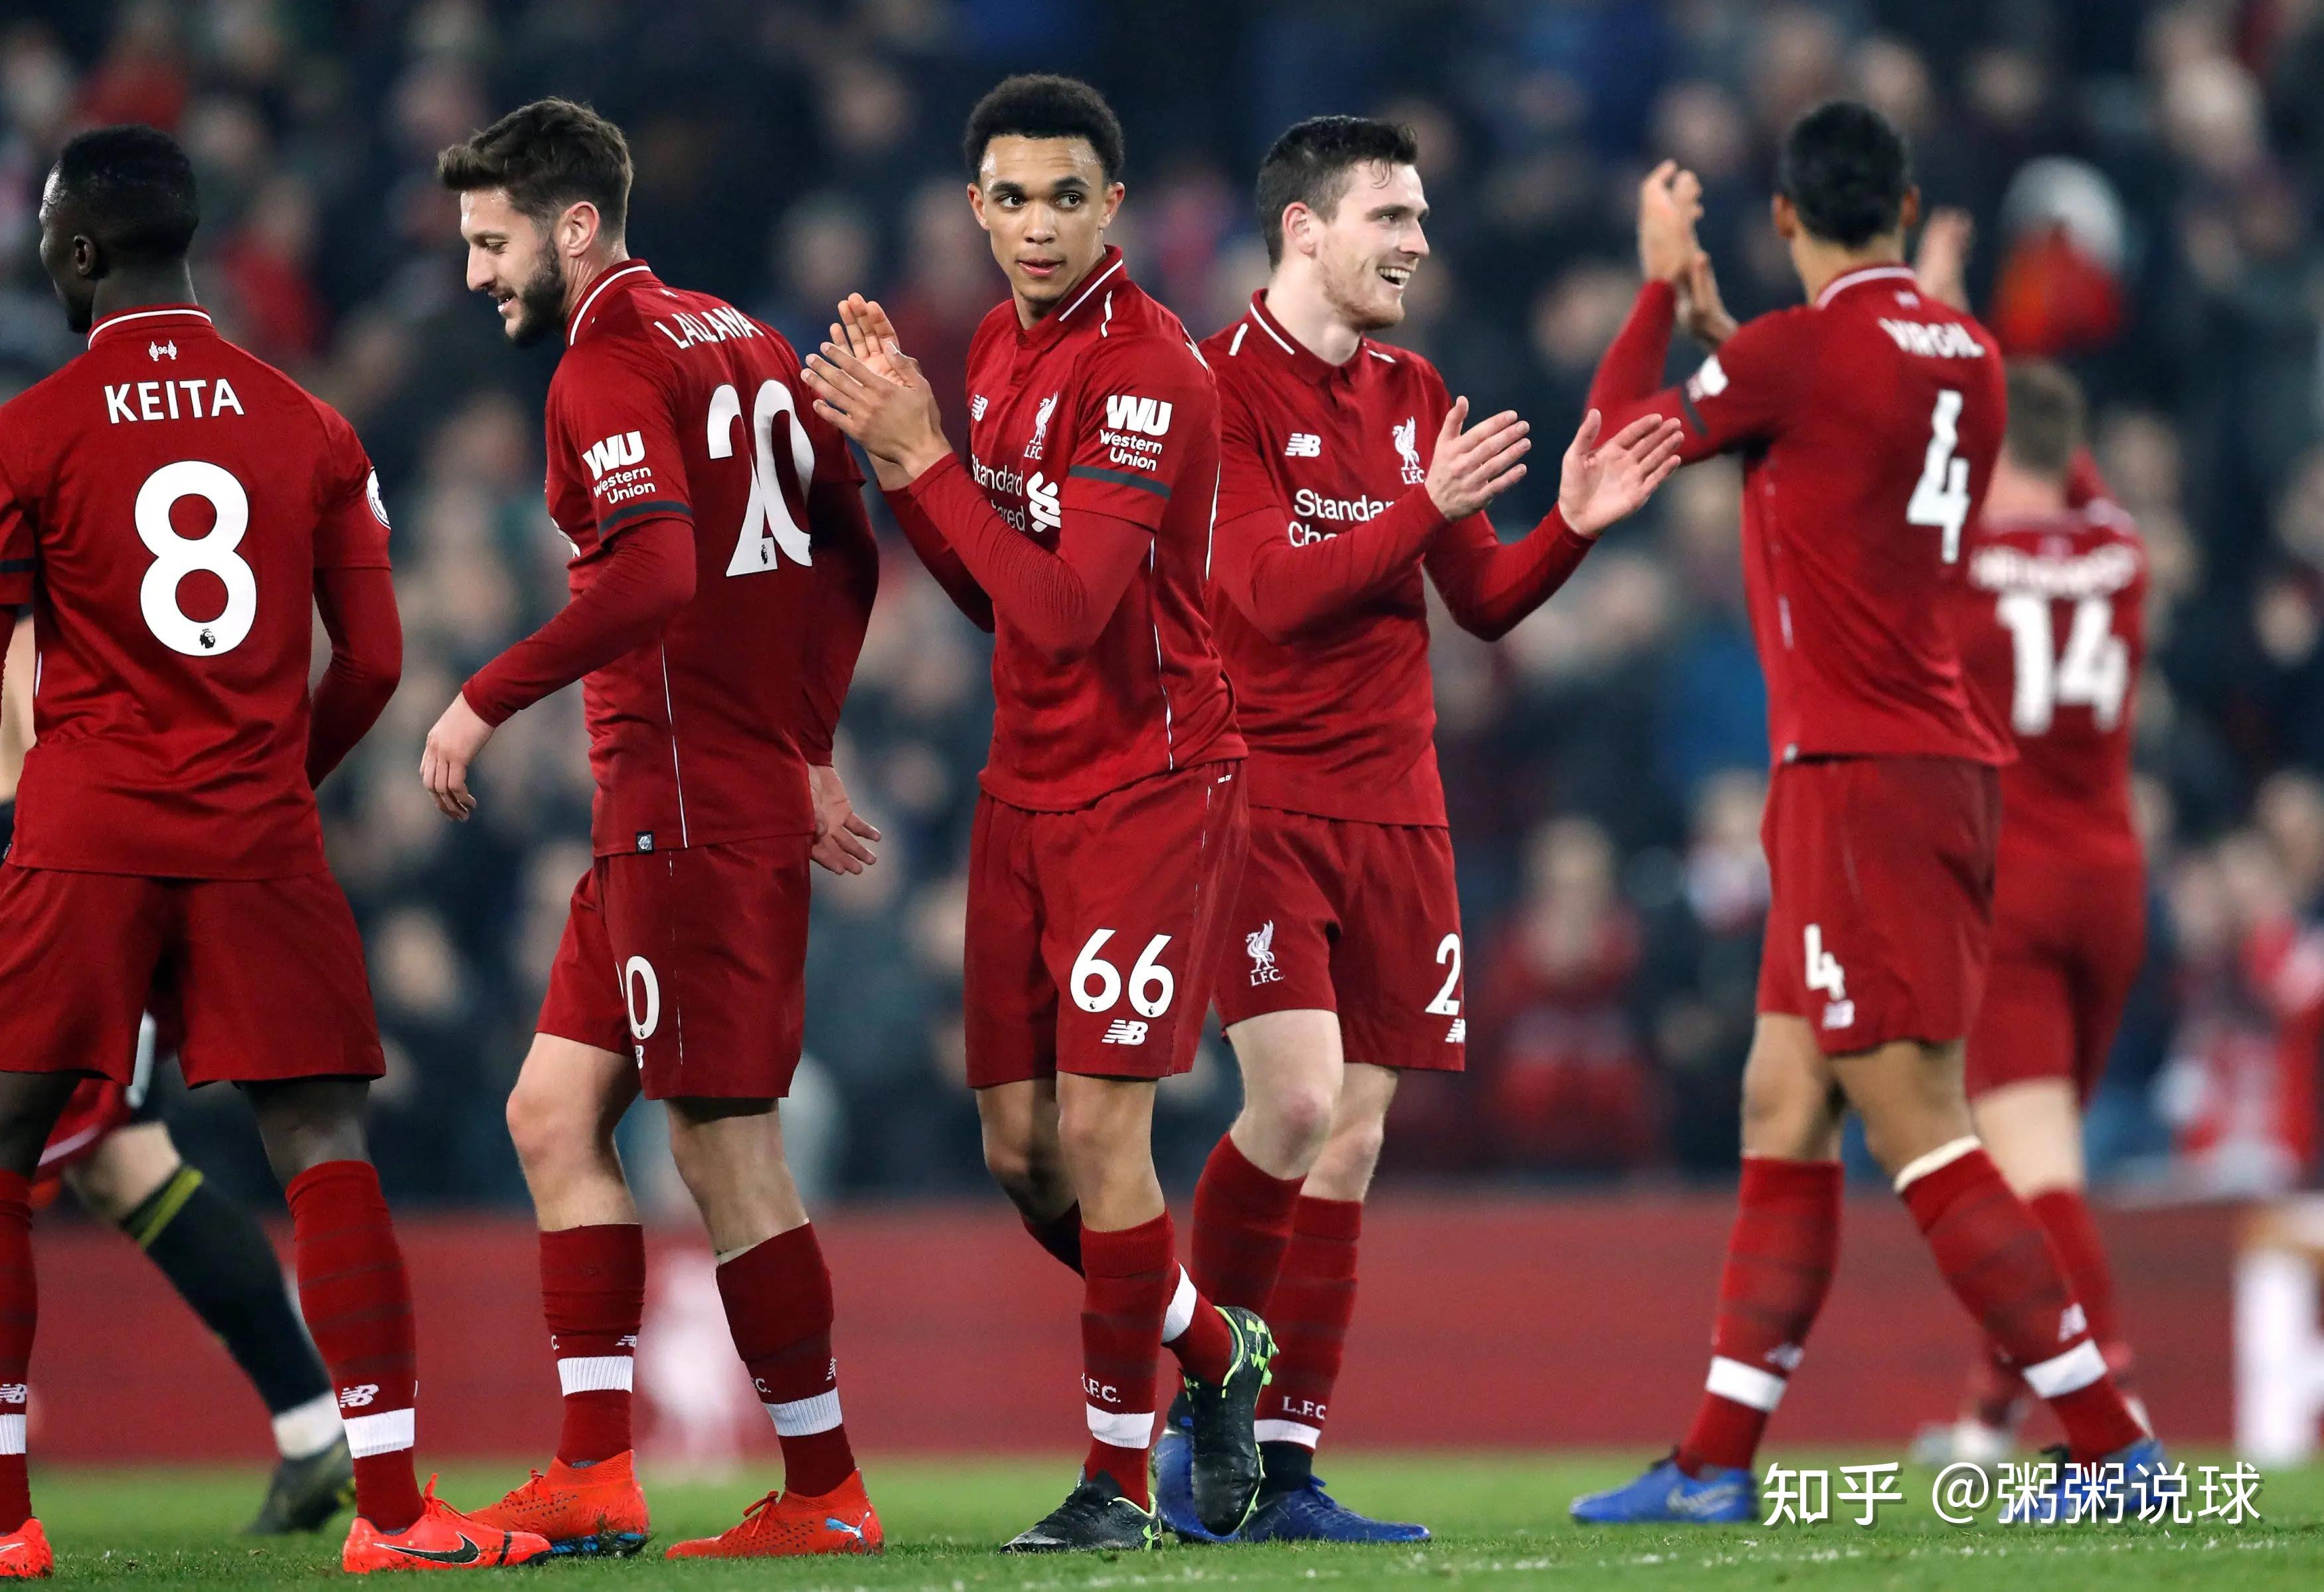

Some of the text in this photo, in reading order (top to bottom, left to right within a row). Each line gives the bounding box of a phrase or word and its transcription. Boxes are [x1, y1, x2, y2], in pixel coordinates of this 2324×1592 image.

[157, 346, 168, 355] 96
[653, 307, 764, 349] LALLANA
[104, 378, 244, 424] KEITA
[1100, 429, 1163, 454] Western
[1110, 446, 1157, 472] Union
[594, 466, 652, 498] Western
[607, 481, 656, 505] Union
[707, 379, 815, 577] 20
[1907, 389, 1971, 564] 4
[134, 460, 258, 657] 8
[1995, 590, 2131, 736] 14
[1070, 928, 1174, 1018] 66
[1803, 923, 1846, 1000] 4
